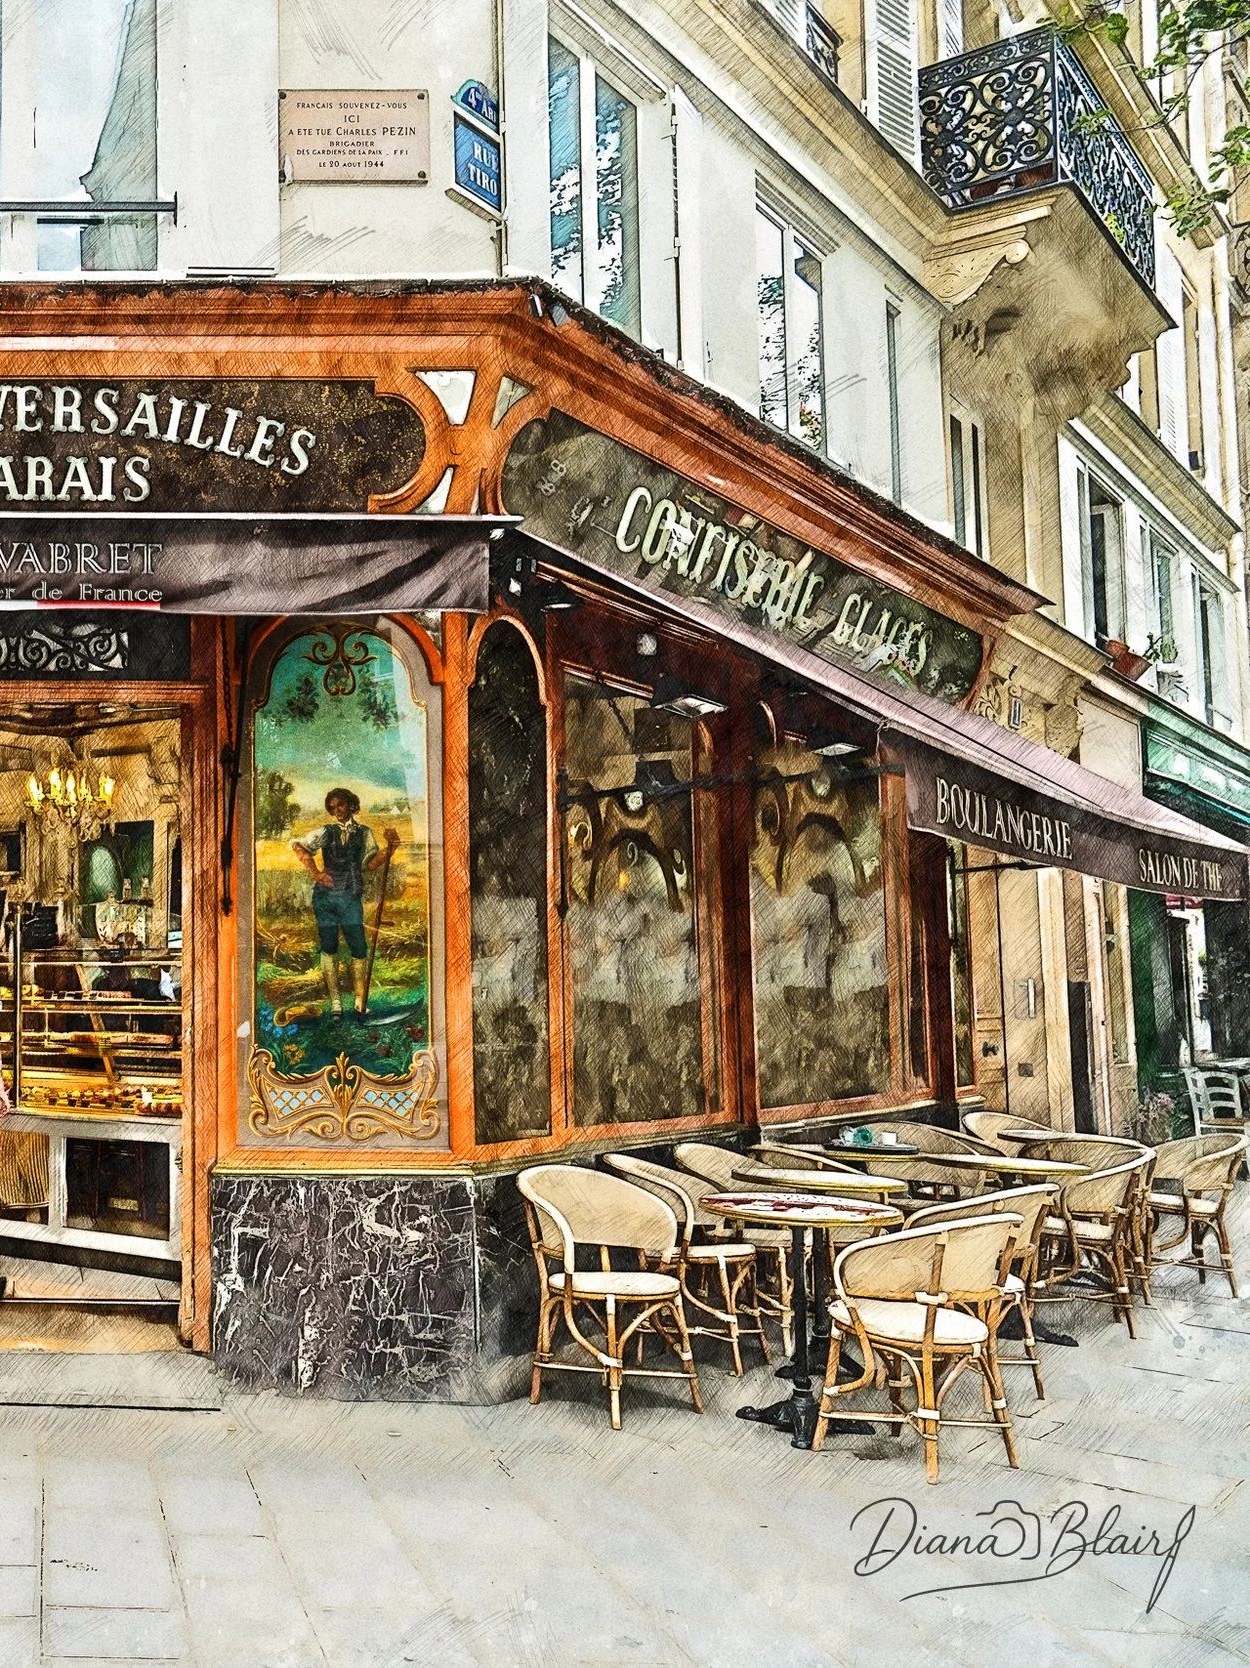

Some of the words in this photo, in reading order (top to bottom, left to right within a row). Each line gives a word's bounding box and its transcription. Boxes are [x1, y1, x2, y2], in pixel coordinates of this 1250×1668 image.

[338, 102, 407, 110] SOUVENEZ-VOUS
[344, 115, 360, 123] ICI
[288, 128, 294, 136] A
[382, 127, 416, 136] PEZIN
[473, 141, 499, 173] RUE
[31, 580, 63, 600] de
[79, 583, 163, 602] France
[936, 777, 1073, 860] BOULANGERIE
[1138, 848, 1182, 887] SALON
[1183, 857, 1200, 889] DE
